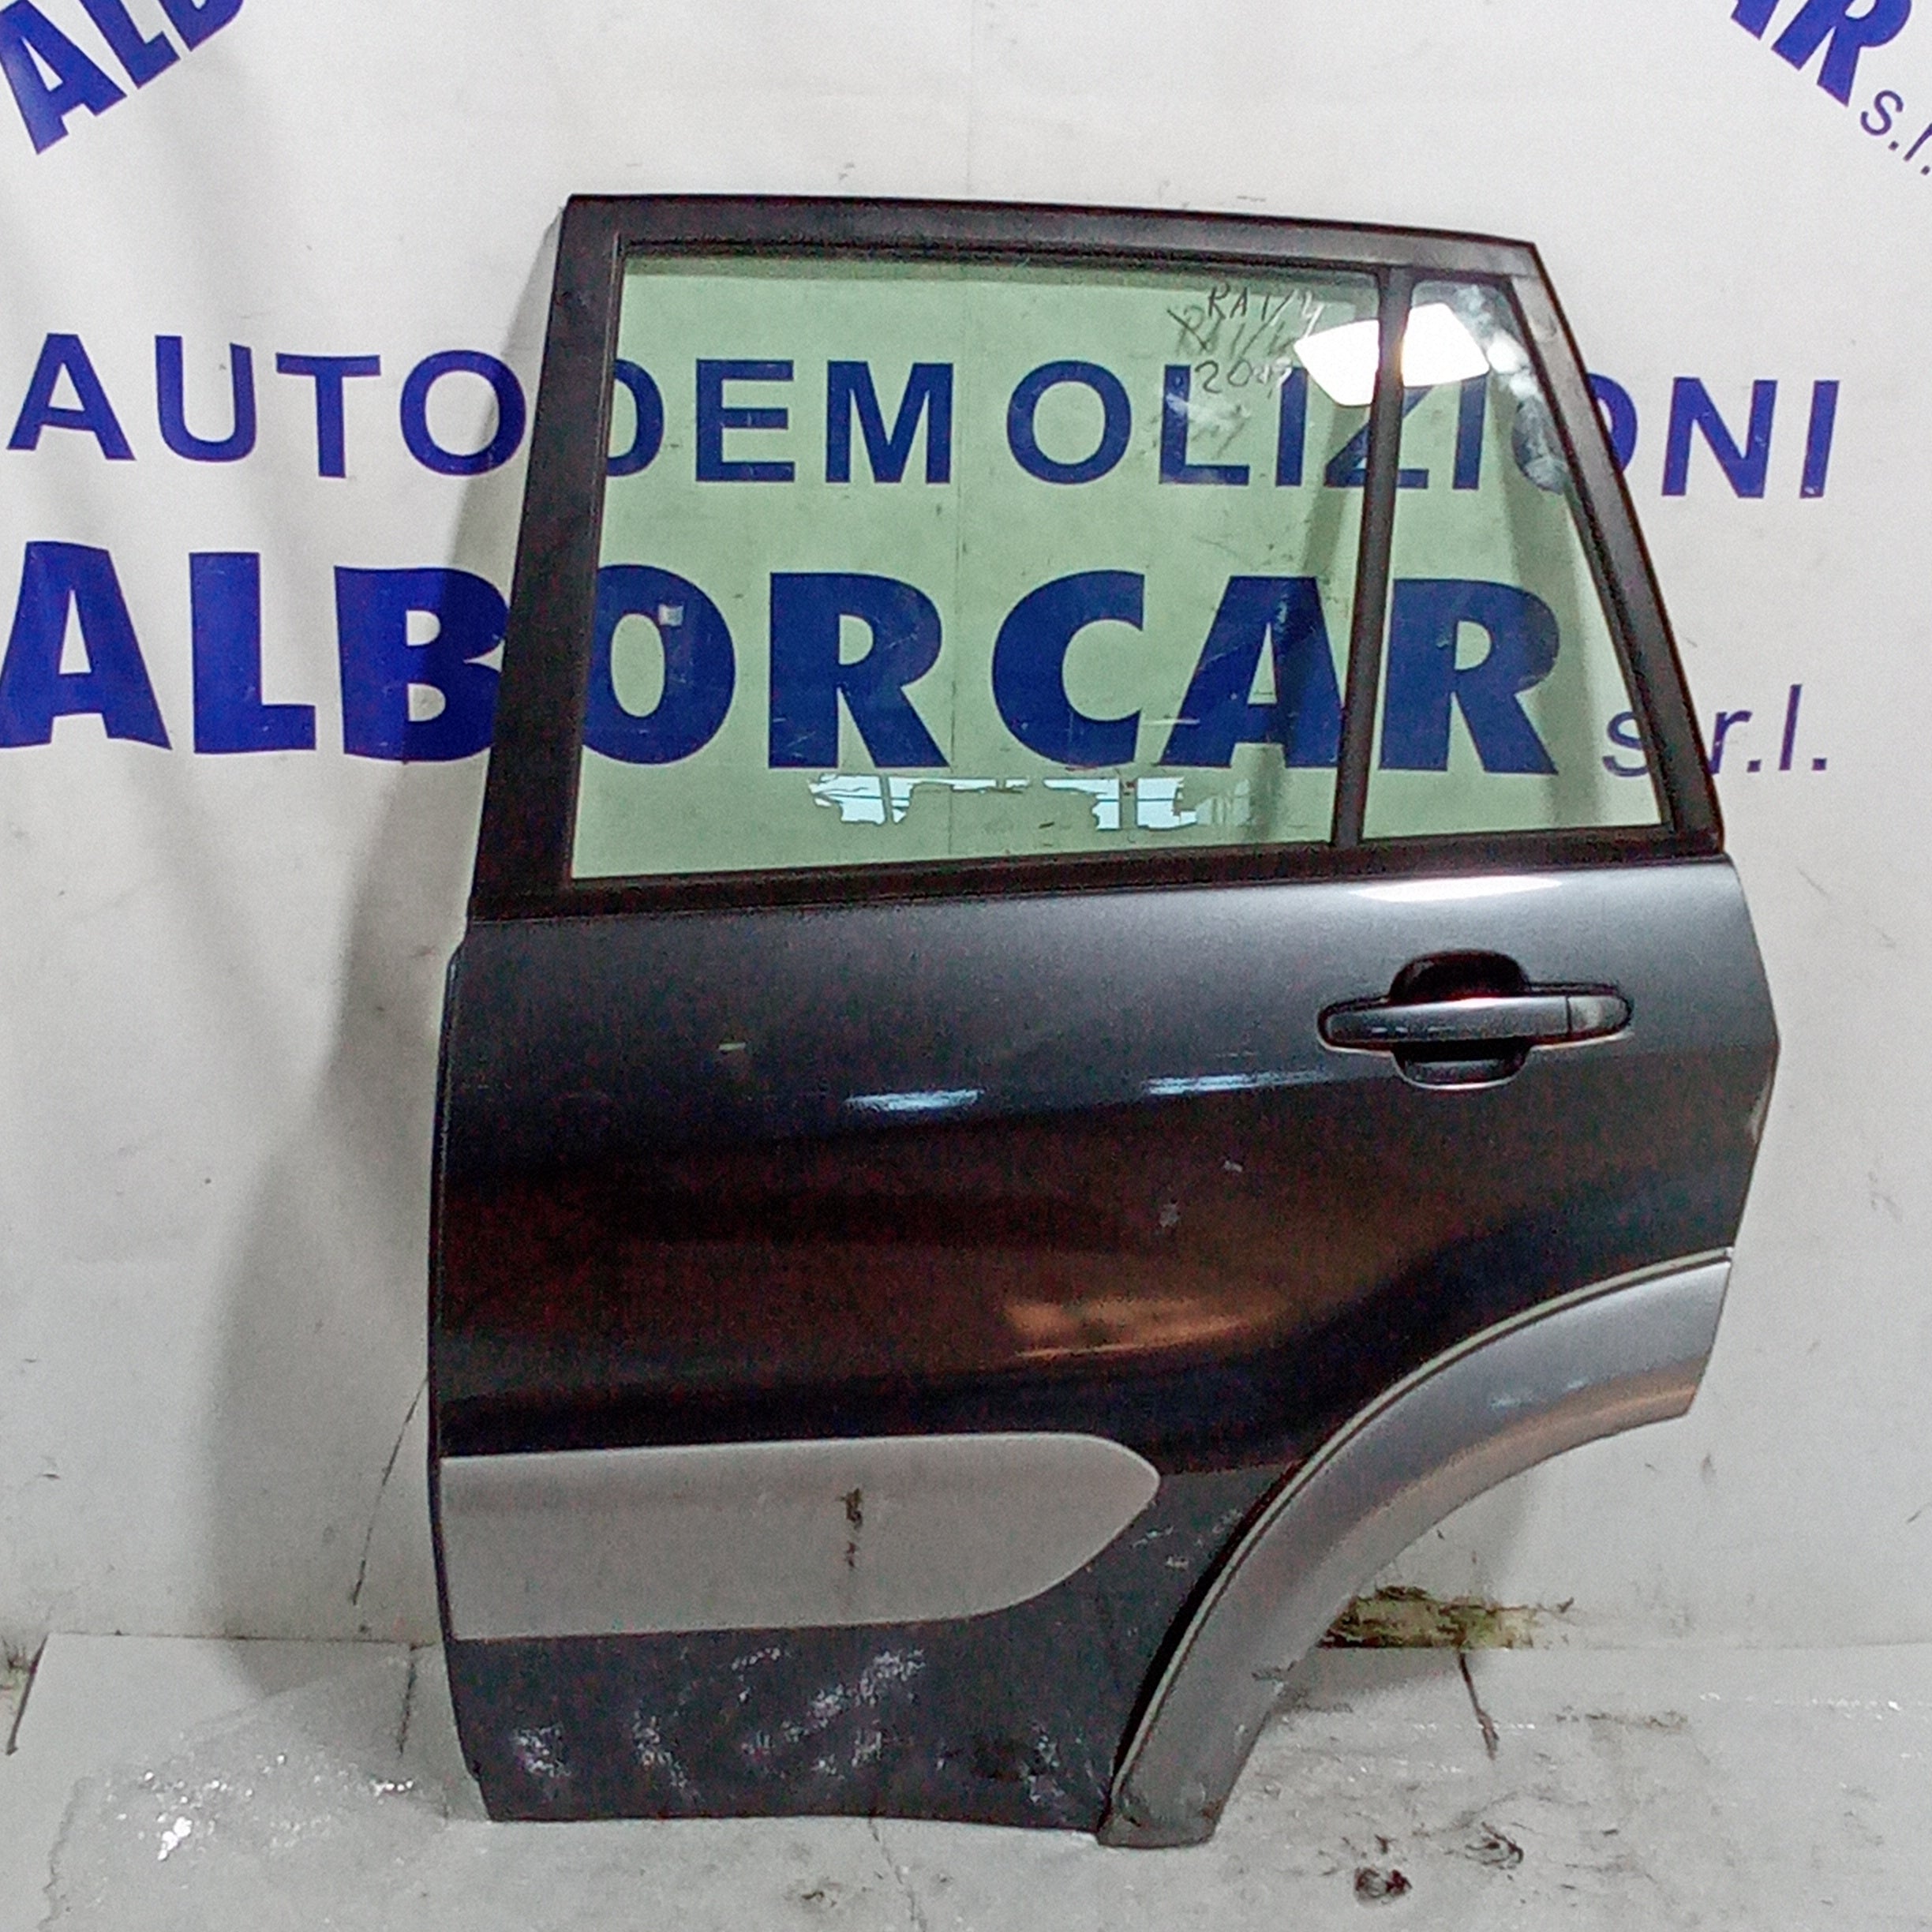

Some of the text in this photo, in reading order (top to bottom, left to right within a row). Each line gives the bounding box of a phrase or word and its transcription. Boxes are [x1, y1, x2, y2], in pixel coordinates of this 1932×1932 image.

[1731, 0, 1912, 107] R
[0, 541, 1828, 778] ALBORCAR sr.l.
